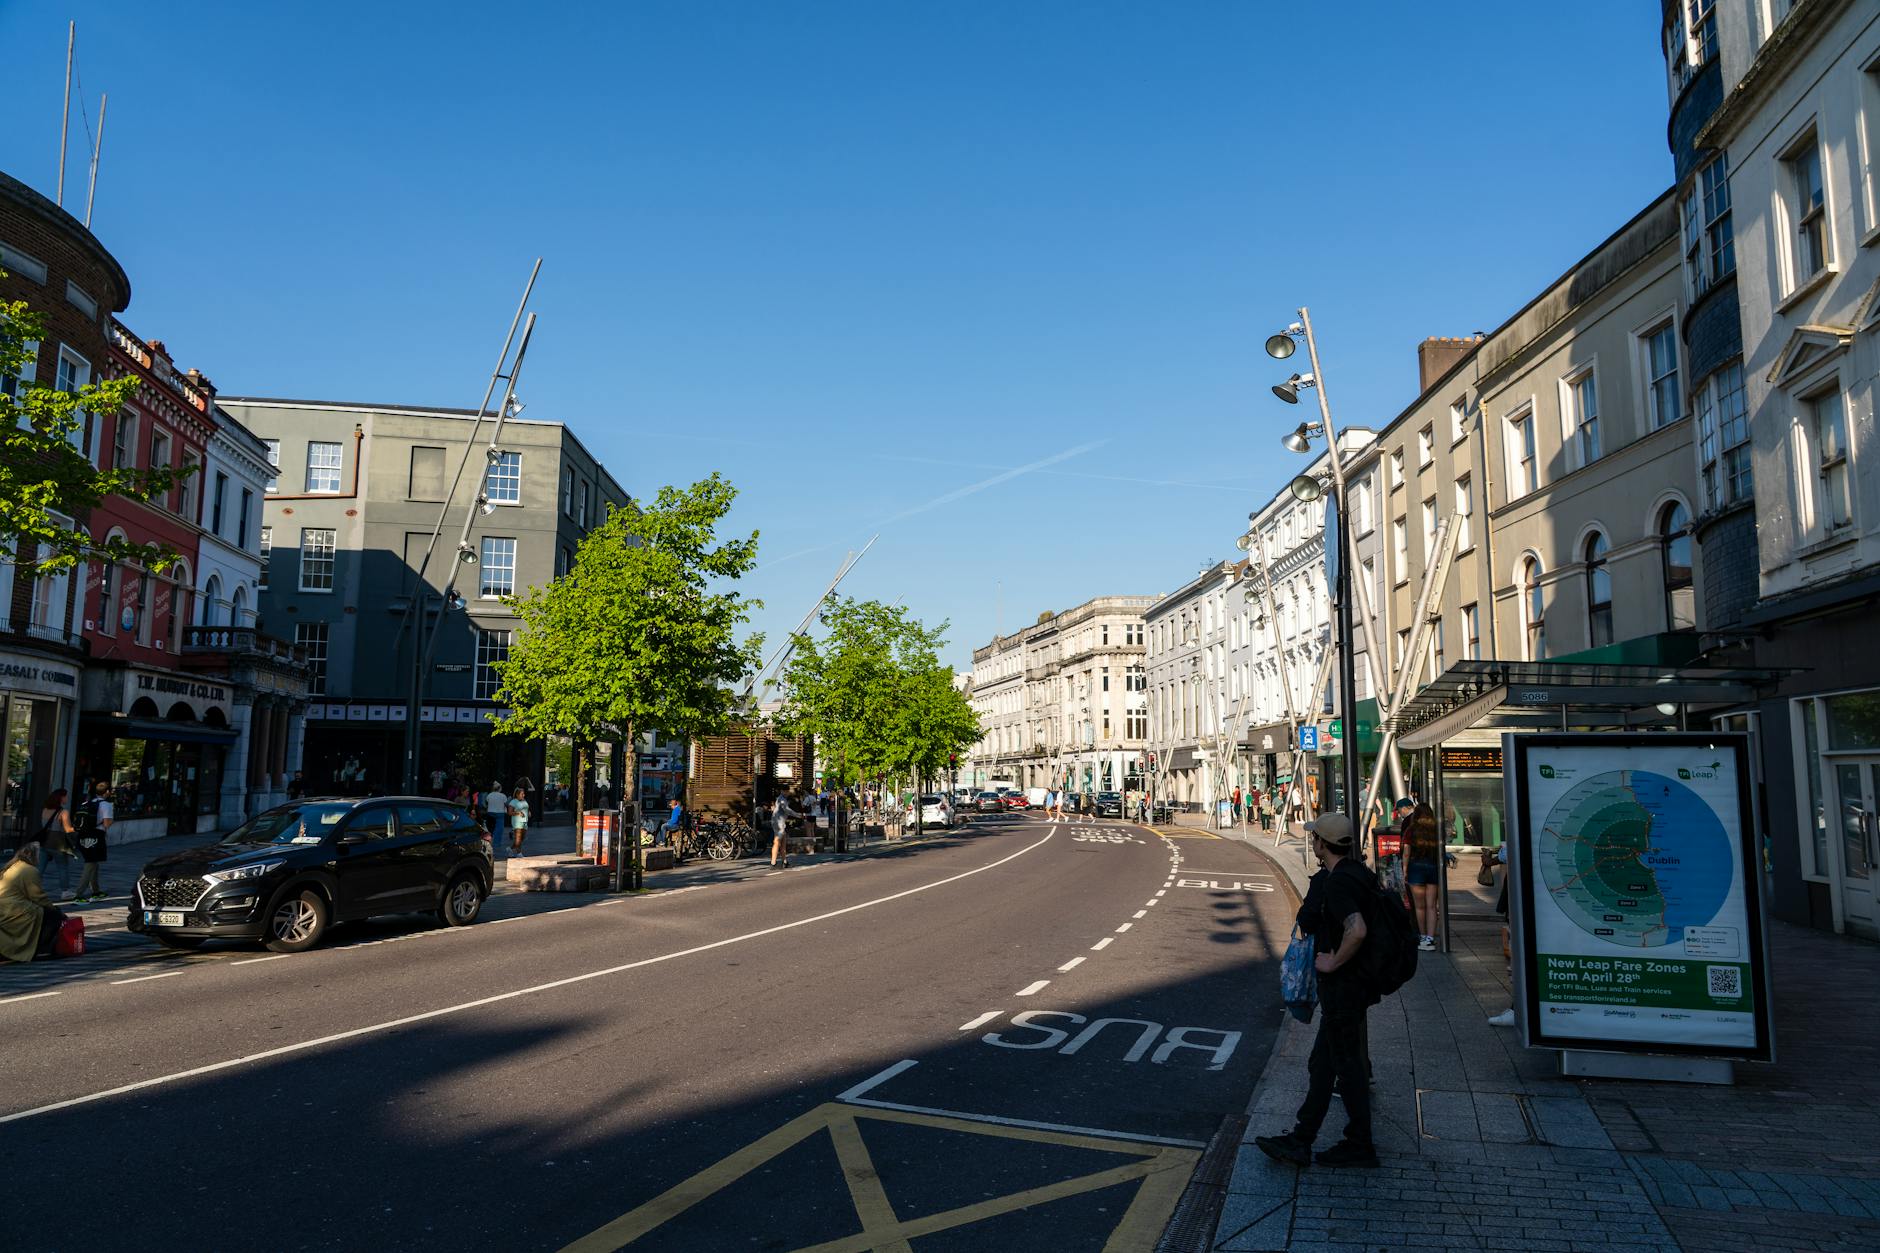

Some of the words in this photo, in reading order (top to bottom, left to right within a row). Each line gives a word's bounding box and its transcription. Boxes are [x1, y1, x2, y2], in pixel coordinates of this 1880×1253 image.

[1522, 693, 1547, 701] 5086
[1692, 770, 1713, 779] Leap
[1648, 856, 1681, 866] Dublin
[1177, 879, 1274, 892] BUS
[1548, 958, 1575, 968] New
[1579, 959, 1610, 971] Leap
[1614, 961, 1642, 971] Fare
[1646, 962, 1686, 973] Zones
[1548, 970, 1578, 981] from
[1582, 972, 1612, 983] April
[1617, 973, 1640, 983] 28th
[1564, 994, 1636, 1004] transportforireland.ie
[981, 1010, 1242, 1071] BUS
